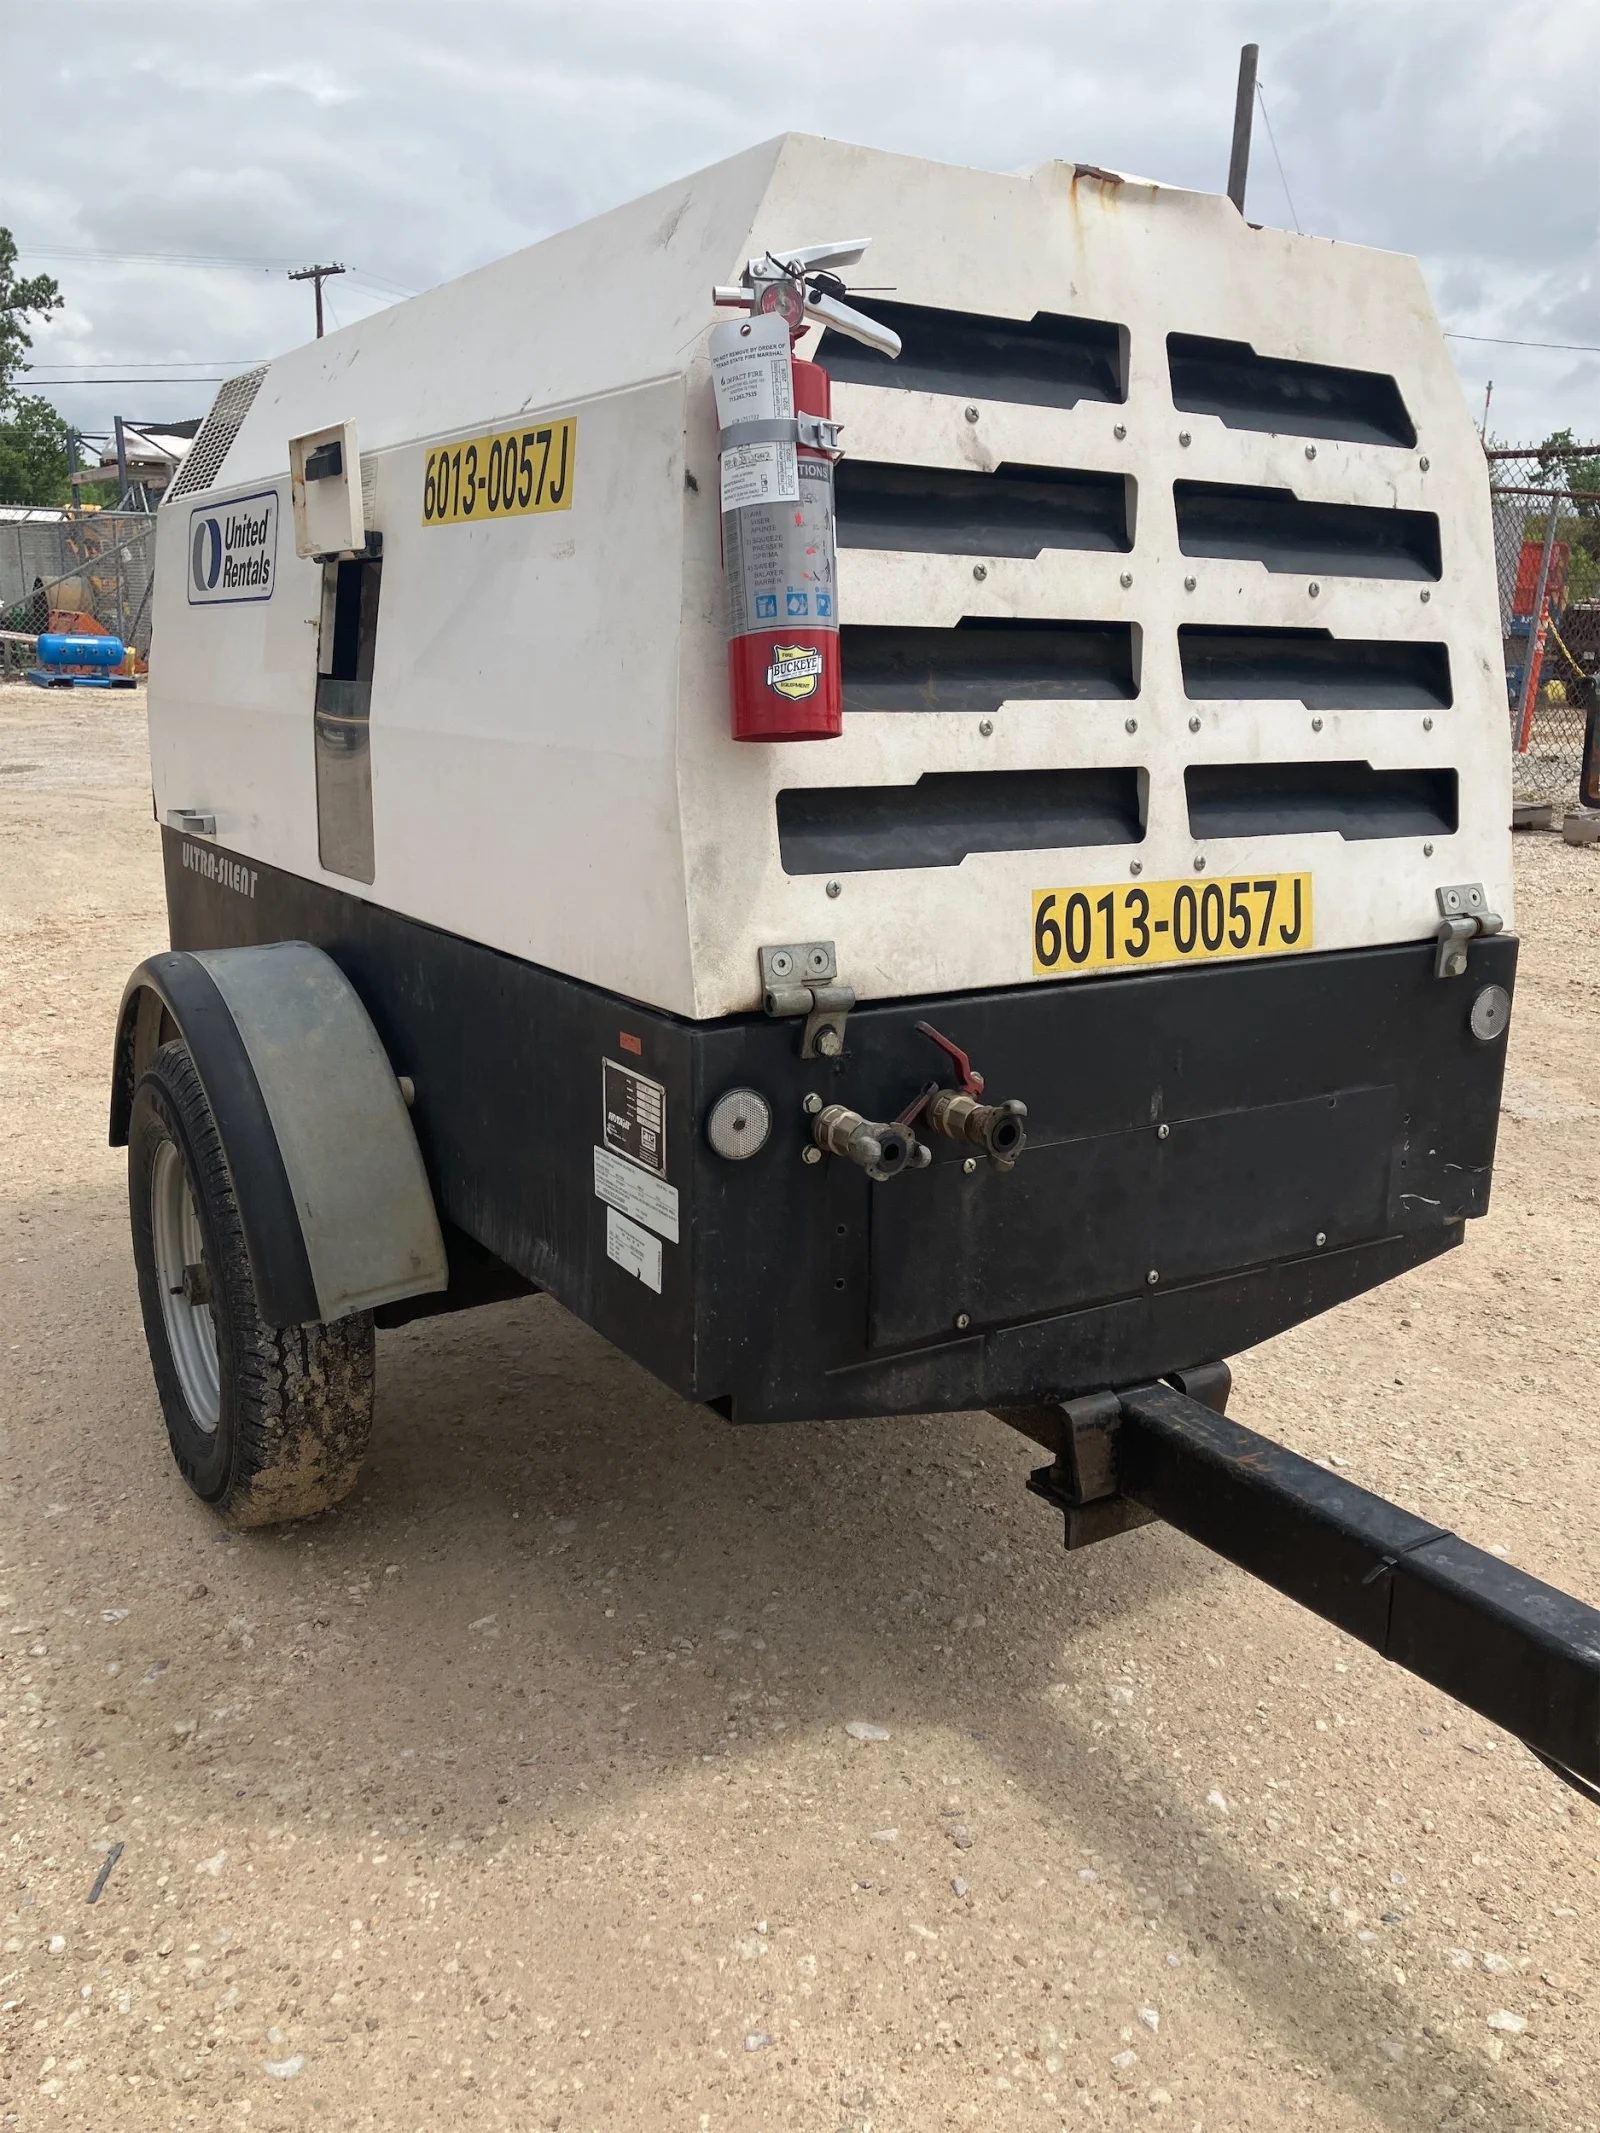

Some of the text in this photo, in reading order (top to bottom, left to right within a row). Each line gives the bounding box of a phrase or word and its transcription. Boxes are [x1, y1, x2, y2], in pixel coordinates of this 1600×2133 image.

[729, 348, 749, 358] REMOVE
[758, 343, 777, 351] ORDER
[716, 350, 784, 369] TEXAS STATE FIRE MARSHAL
[747, 370, 763, 379] FIRE
[424, 426, 569, 521] 6013-0057J
[750, 510, 762, 518] AIM
[751, 517, 770, 525] VISER
[224, 508, 269, 551] United
[751, 524, 777, 533] APUNTE
[752, 534, 783, 544] SQUEEZE
[752, 543, 784, 552] PRESSER
[753, 551, 779, 560] OPRIMA
[222, 549, 270, 589] Rentals
[754, 561, 777, 571] SWEEP
[754, 569, 784, 579] BALAYER
[754, 577, 783, 586] BARRER
[774, 657, 817, 676] BUCKEYE
[182, 841, 258, 899] ULTRA-SILENT
[1035, 878, 1301, 967] 6013-0057J
